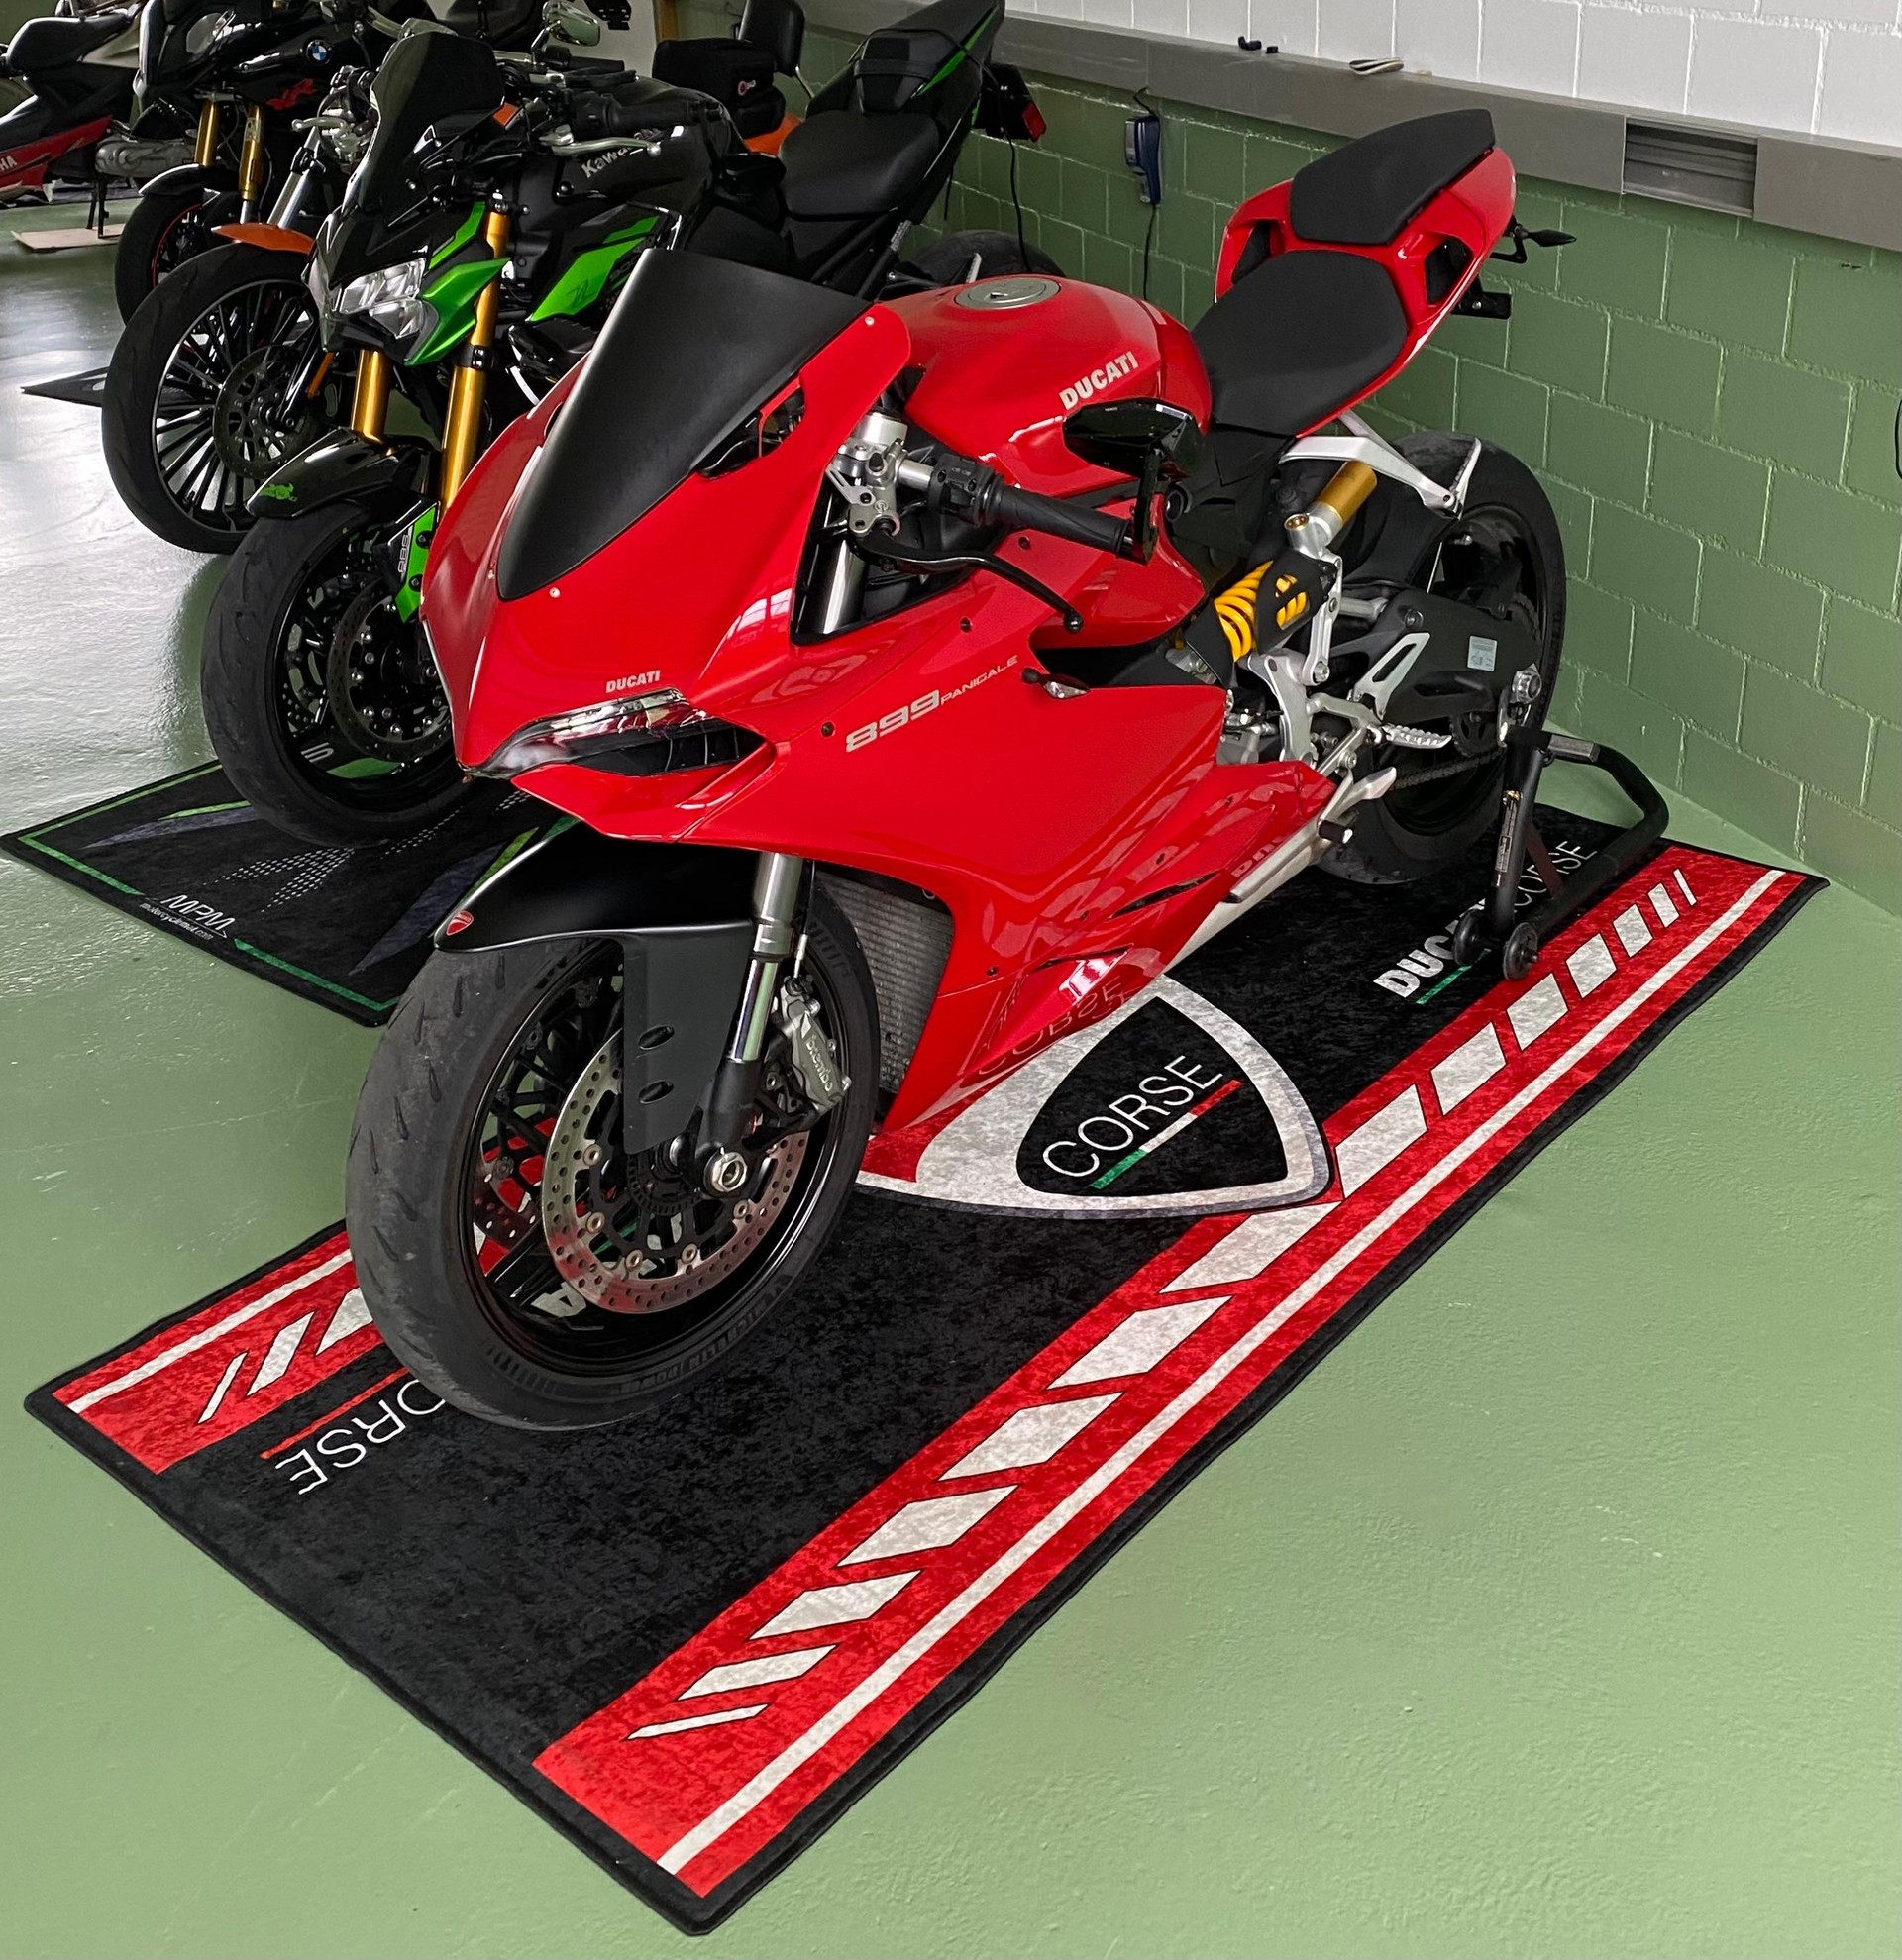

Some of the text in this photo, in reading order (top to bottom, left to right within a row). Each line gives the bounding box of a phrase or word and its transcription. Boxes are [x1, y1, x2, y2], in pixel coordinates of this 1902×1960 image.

[1059, 351, 1139, 410] DUCATI
[606, 670, 661, 693] DUCATI
[846, 655, 1018, 753] 899 PANIGALE
[160, 894, 236, 930] MPM
[805, 1034, 833, 1092] brembo
[1042, 1055, 1223, 1177] CORSE
[274, 1378, 446, 1496] ORSE
